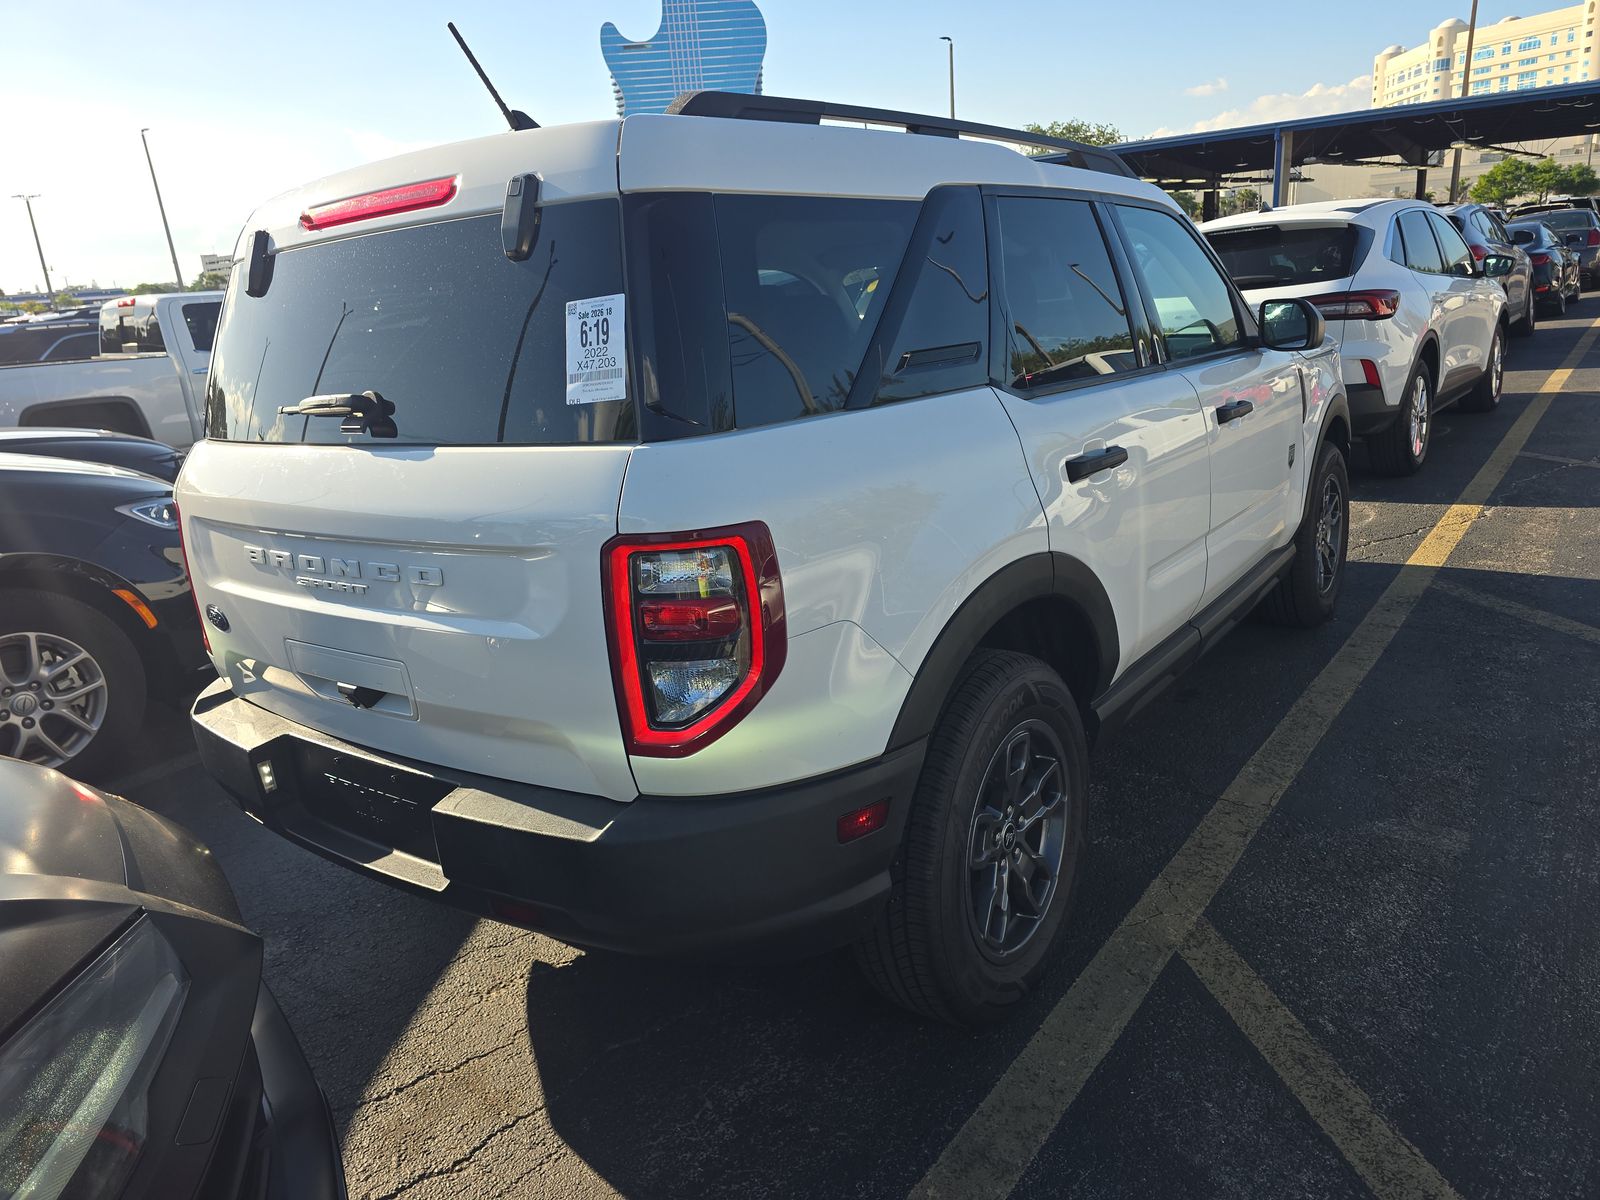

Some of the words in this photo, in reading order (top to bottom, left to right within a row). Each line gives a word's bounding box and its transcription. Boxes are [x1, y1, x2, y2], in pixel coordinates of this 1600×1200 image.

[578, 311, 590, 320] Sale
[606, 307, 613, 316] 18
[580, 317, 610, 348] 6:19
[584, 346, 609, 359] 2022
[576, 357, 617, 371] X47,203
[243, 545, 443, 586] BRONCO
[296, 575, 370, 595] SPORT
